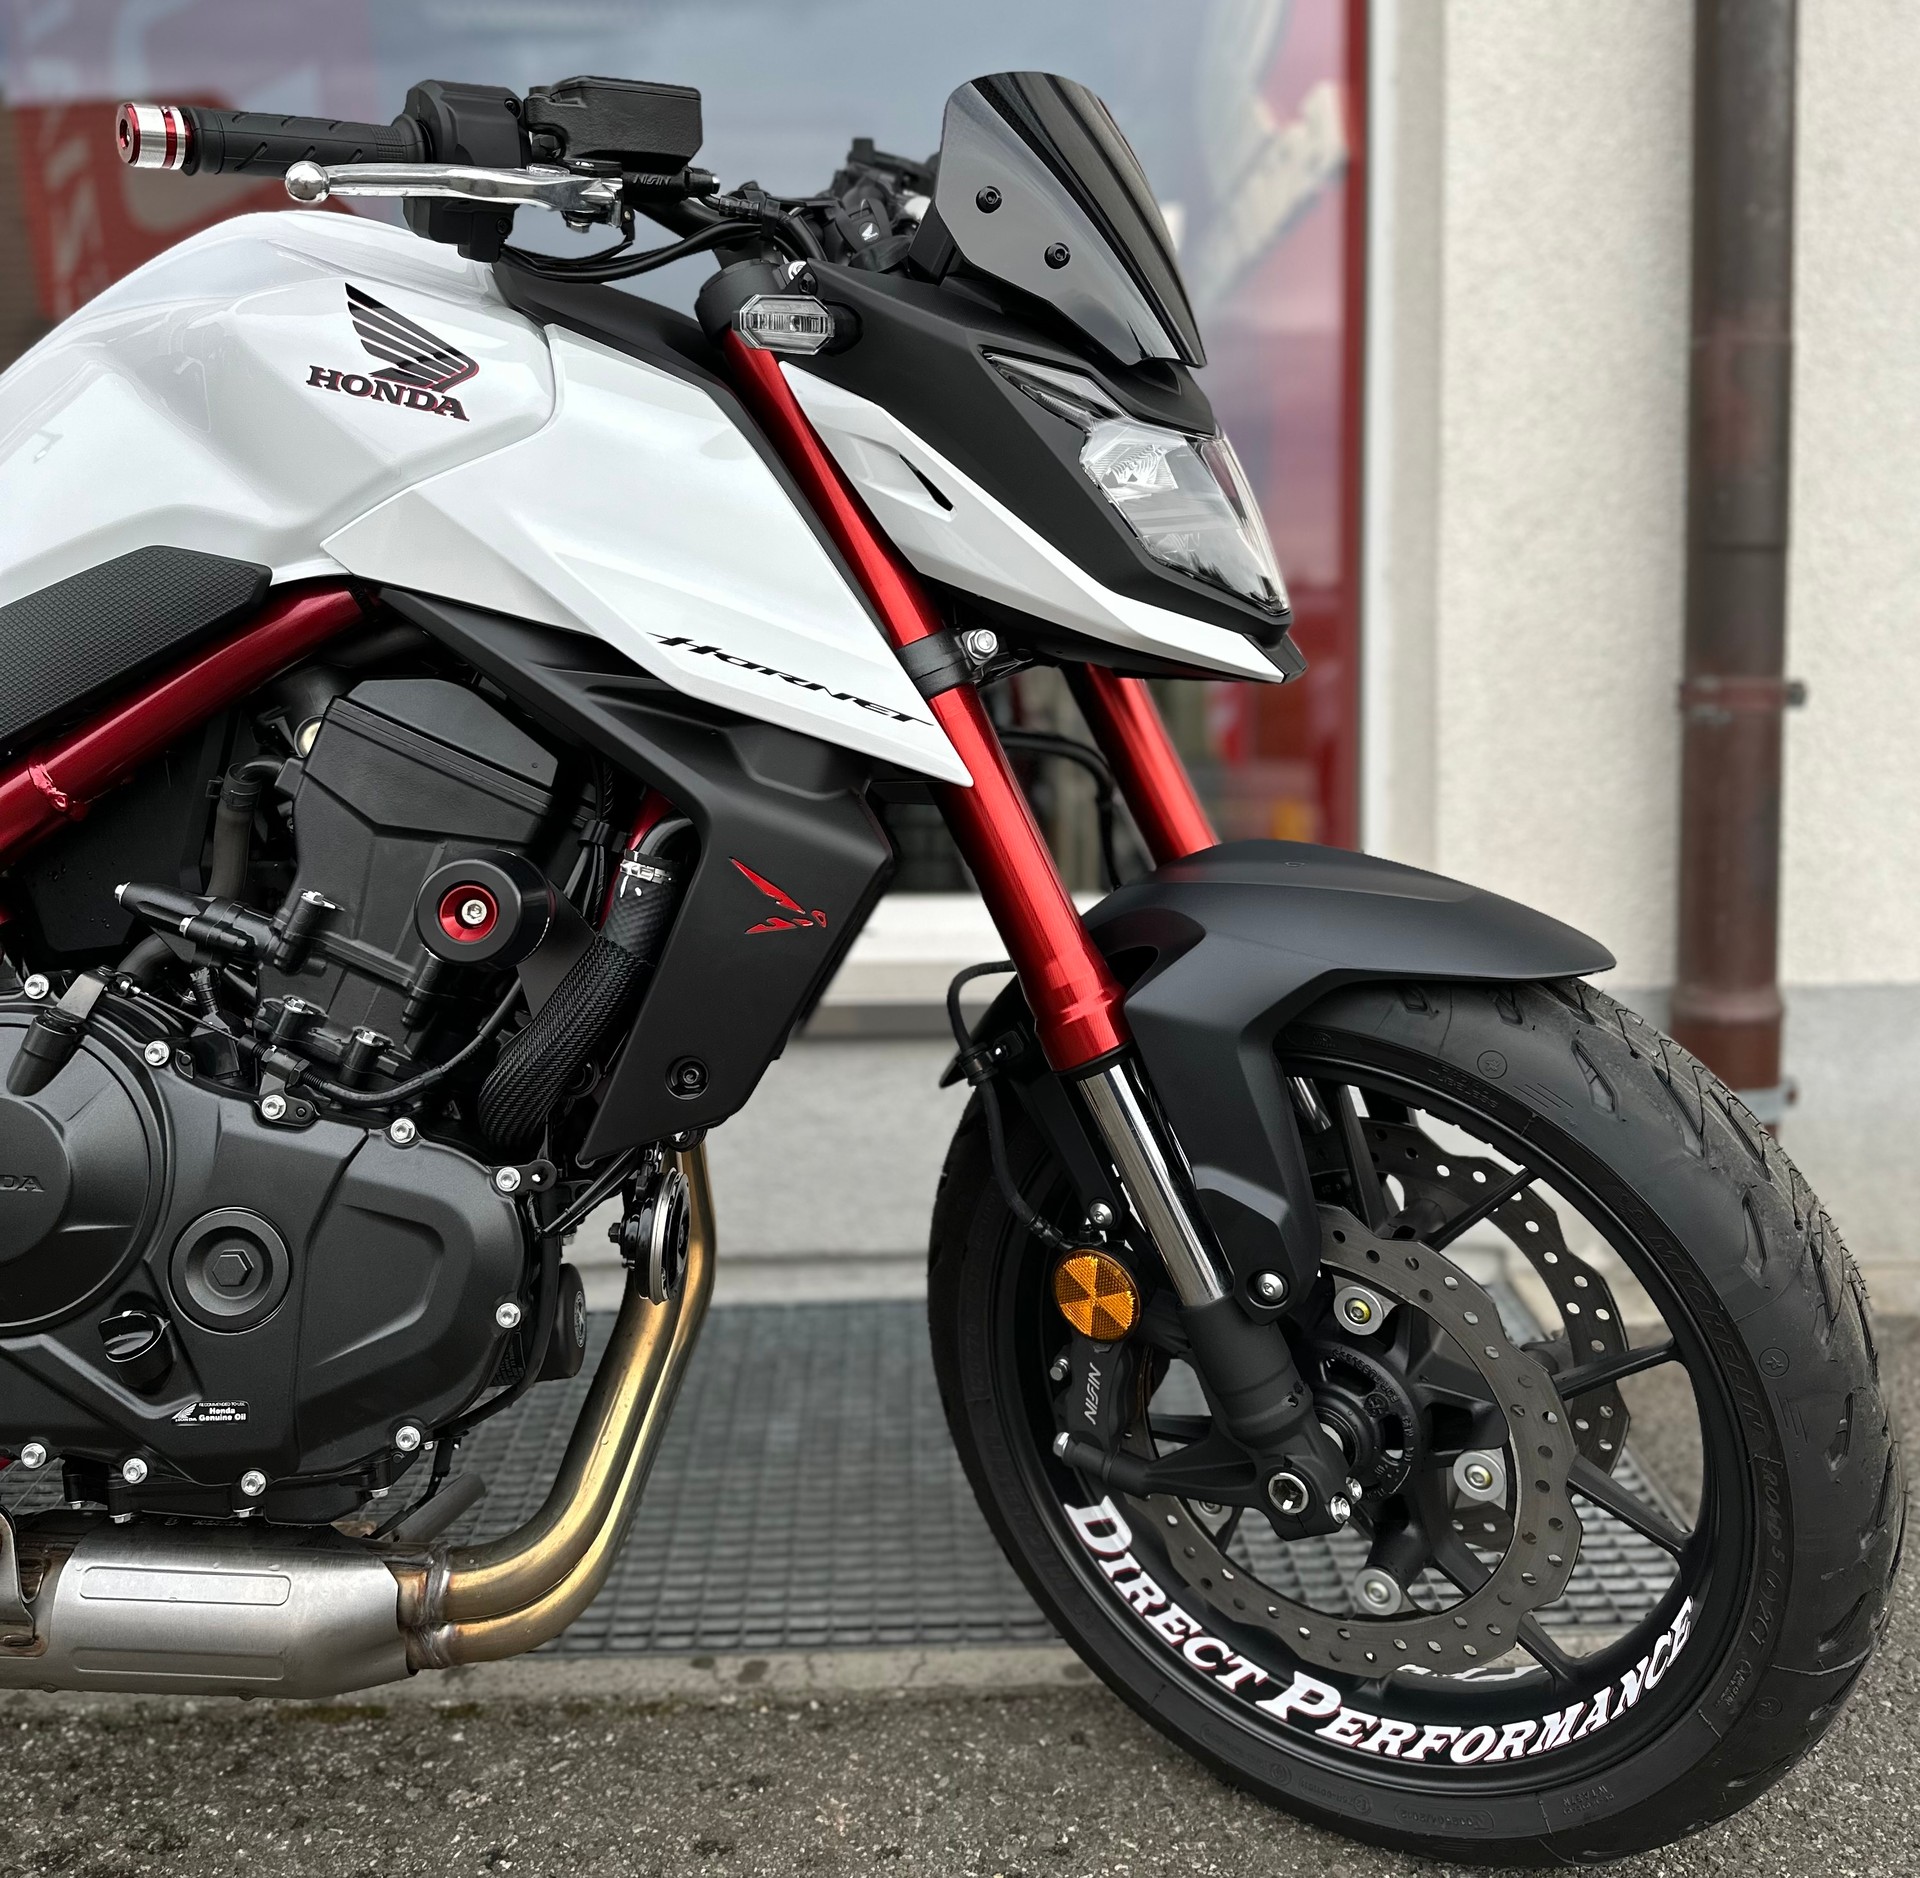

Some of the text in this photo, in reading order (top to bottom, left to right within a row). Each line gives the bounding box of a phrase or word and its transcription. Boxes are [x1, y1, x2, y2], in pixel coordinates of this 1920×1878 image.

[306, 365, 469, 421] HONDA
[198, 1413, 247, 1422] Genuine Oil
[209, 1407, 236, 1415] Honda
[1064, 1495, 1694, 1765] DIRECT PERFORMANCE
